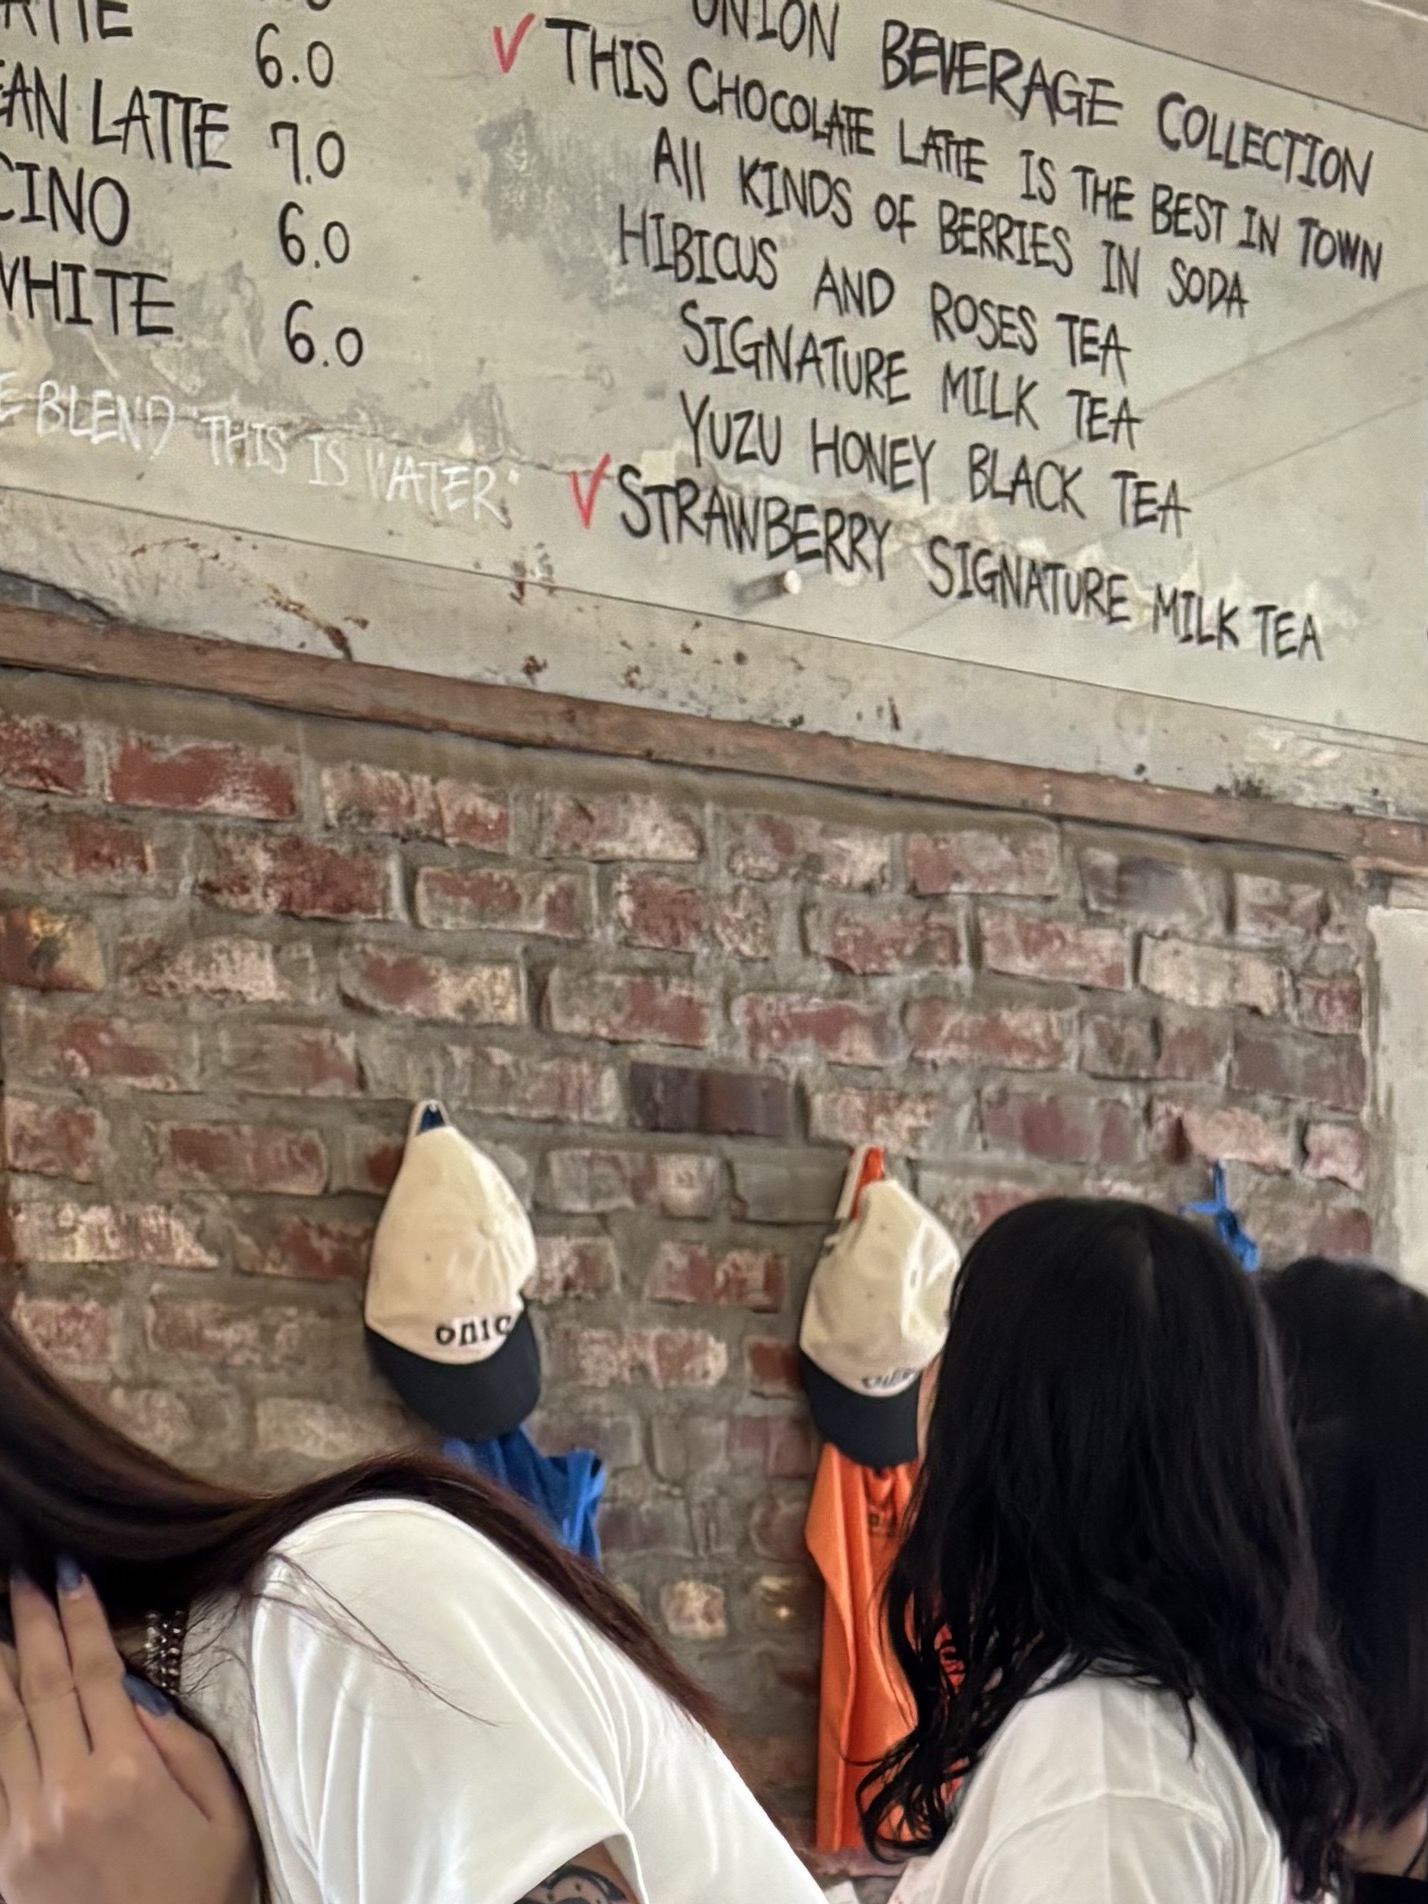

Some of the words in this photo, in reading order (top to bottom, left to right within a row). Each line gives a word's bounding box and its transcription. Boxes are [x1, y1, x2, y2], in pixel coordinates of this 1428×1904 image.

[255, 22, 334, 89] 6.0
[880, 21, 1124, 127] BEVERAGE
[1157, 91, 1374, 197] COLLECTION
[92, 78, 232, 169] LATTE
[271, 120, 347, 186] 7.0
[545, 17, 669, 107] THIS
[687, 57, 875, 156] CHOCOLATE
[899, 119, 988, 184] LATTE
[1018, 149, 1056, 206] IS
[1072, 165, 1135, 222] THE
[1152, 182, 1229, 243] BEST
[1238, 205, 1280, 257] IN
[1298, 217, 1383, 282] TOWN
[278, 201, 351, 269] 6.0
[619, 203, 778, 290] HIBICUS
[813, 258, 896, 318] AND
[930, 281, 1039, 356] ROSES
[1056, 313, 1132, 387] TEA
[738, 155, 853, 228] KINDS
[875, 193, 917, 244] OF
[938, 199, 1074, 277] BERRIES
[1101, 239, 1141, 298] IN
[1167, 257, 1249, 319] SODA
[284, 299, 364, 368] 6.0
[679, 299, 912, 405] SIGNATURE
[941, 361, 1039, 431] MILK
[1066, 388, 1147, 450] TEA
[36, 379, 175, 461] BLEND
[200, 415, 287, 475] THIS
[307, 434, 350, 487] IS
[679, 390, 782, 469] YUZU
[810, 417, 937, 504] HONEY
[968, 442, 1087, 520] BLACK
[1111, 470, 1193, 538] TEA
[617, 464, 892, 581] STRAWBERRY
[927, 535, 1131, 625] SIGNATURE
[1152, 583, 1241, 651] MILK
[1253, 605, 1324, 662] TEA
